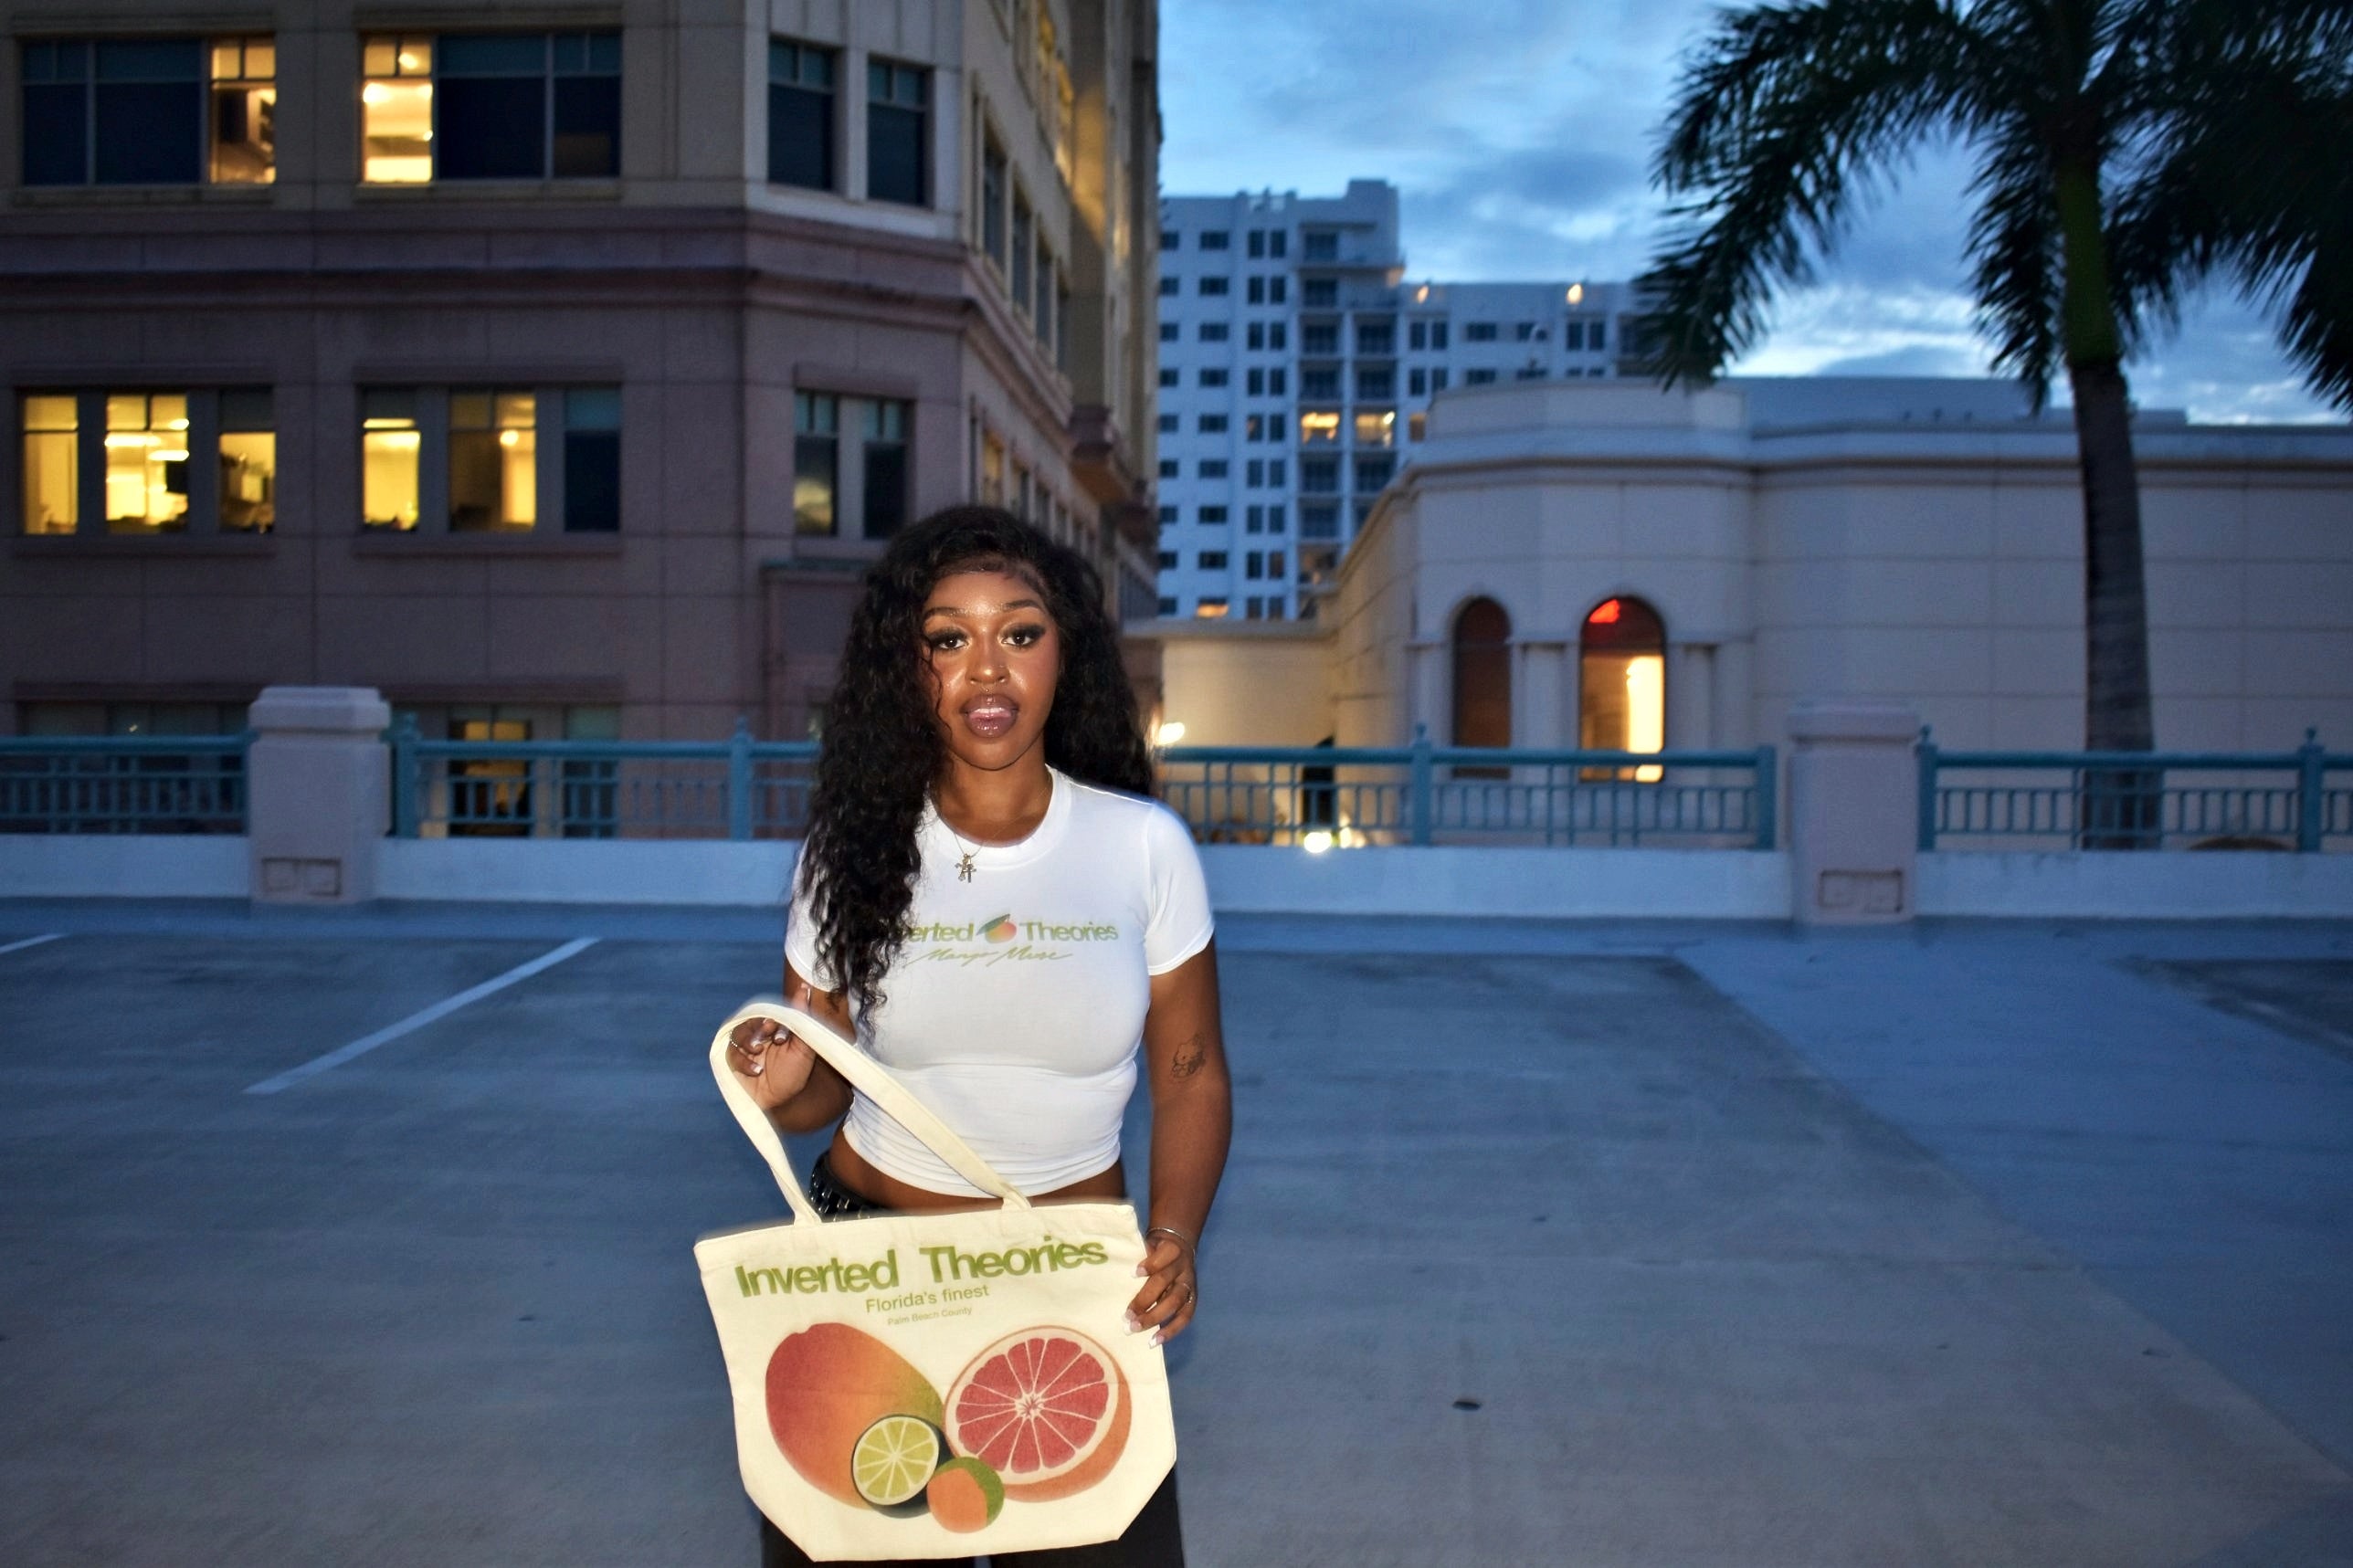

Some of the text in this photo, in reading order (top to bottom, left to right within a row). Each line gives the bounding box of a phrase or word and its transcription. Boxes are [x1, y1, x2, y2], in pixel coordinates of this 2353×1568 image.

[908, 921, 1119, 942] erted Theories
[734, 1236, 1109, 1298] Inverted Theories
[865, 1284, 990, 1313] Florida's finest
[887, 1306, 973, 1326] Palm Beach County
